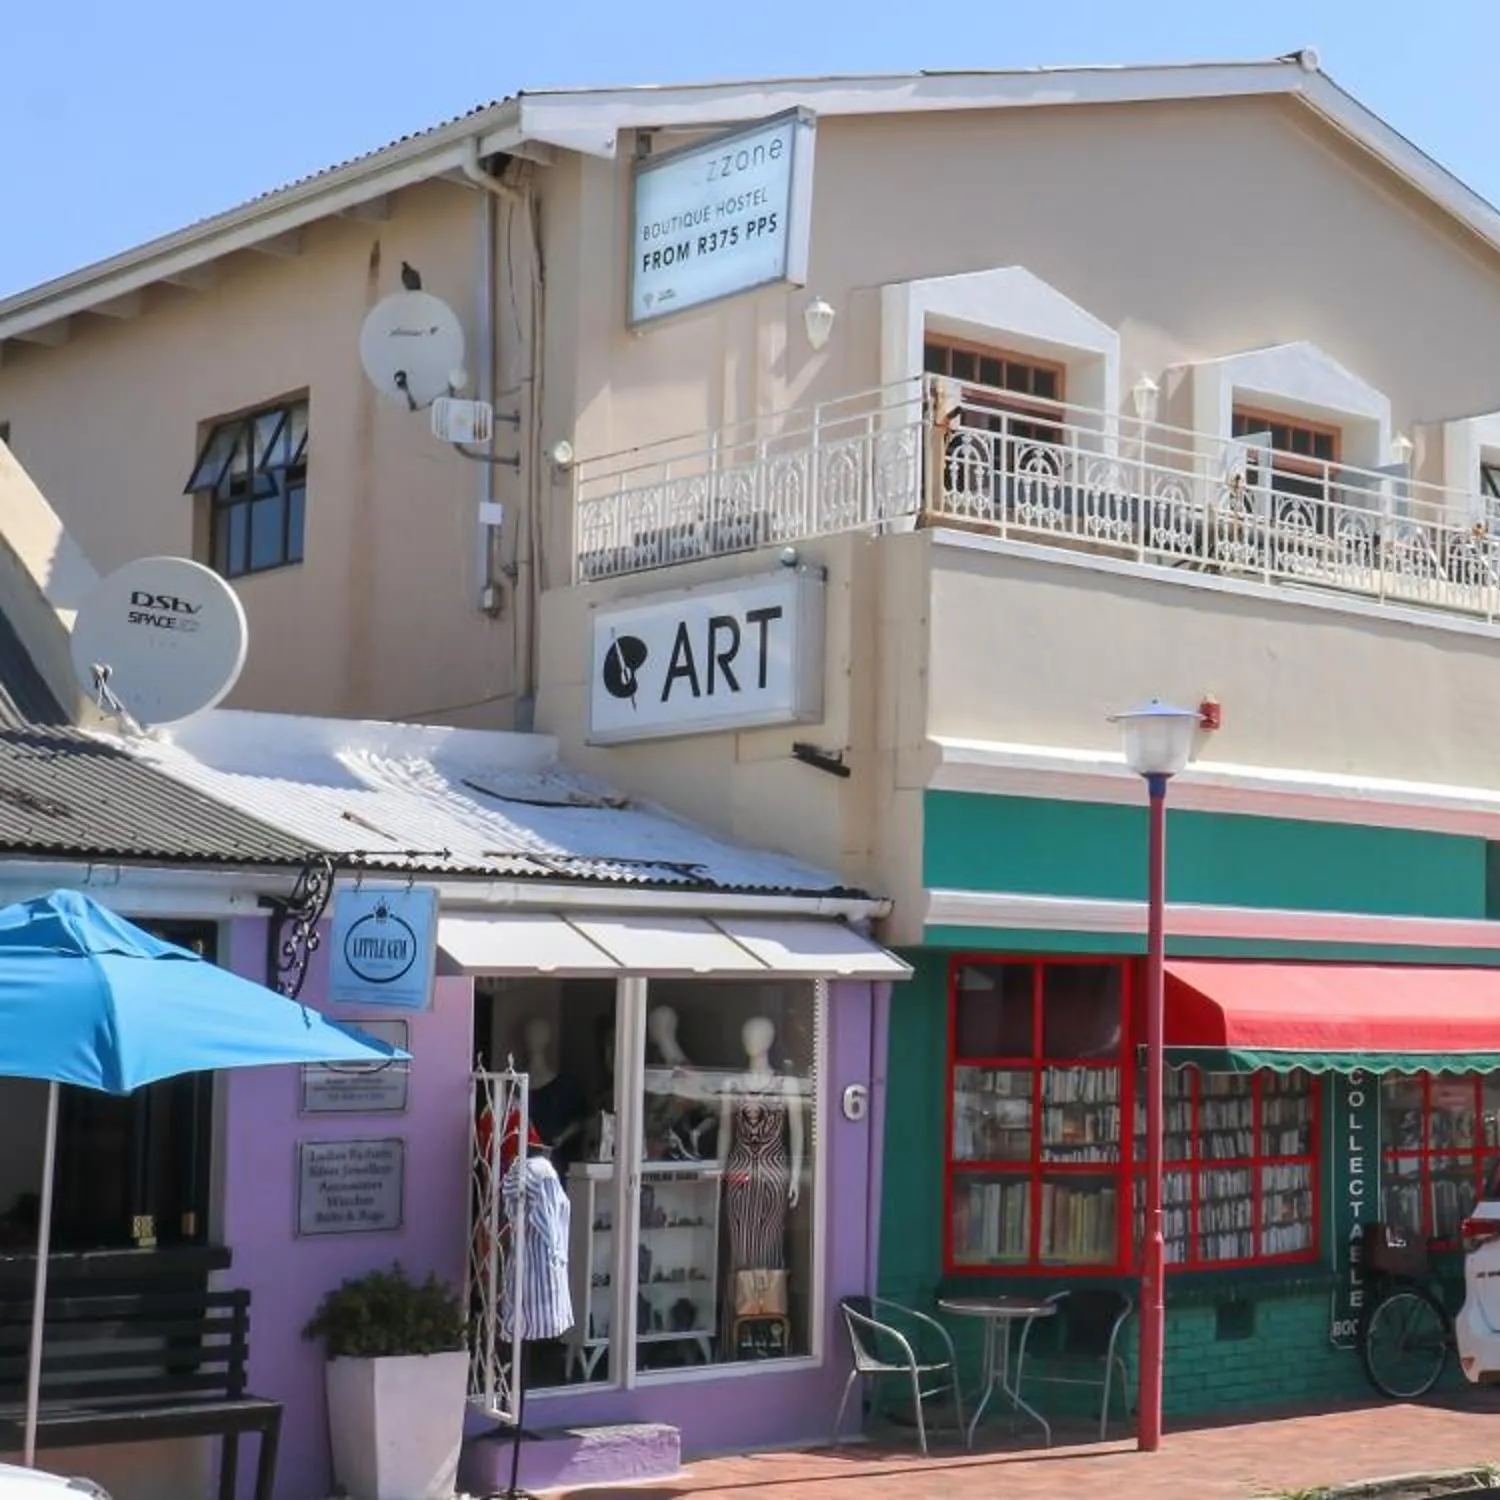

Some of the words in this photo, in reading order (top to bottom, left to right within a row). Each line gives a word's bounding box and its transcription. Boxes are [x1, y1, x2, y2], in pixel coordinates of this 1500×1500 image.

[643, 205, 711, 241] BOUTIQUE
[716, 188, 769, 217] HOSTEL
[643, 241, 690, 273] FROM
[697, 225, 739, 257] R375
[746, 211, 778, 241] PPS
[130, 590, 202, 614] DStv
[661, 606, 783, 702] ART
[843, 1084, 867, 1121] 6
